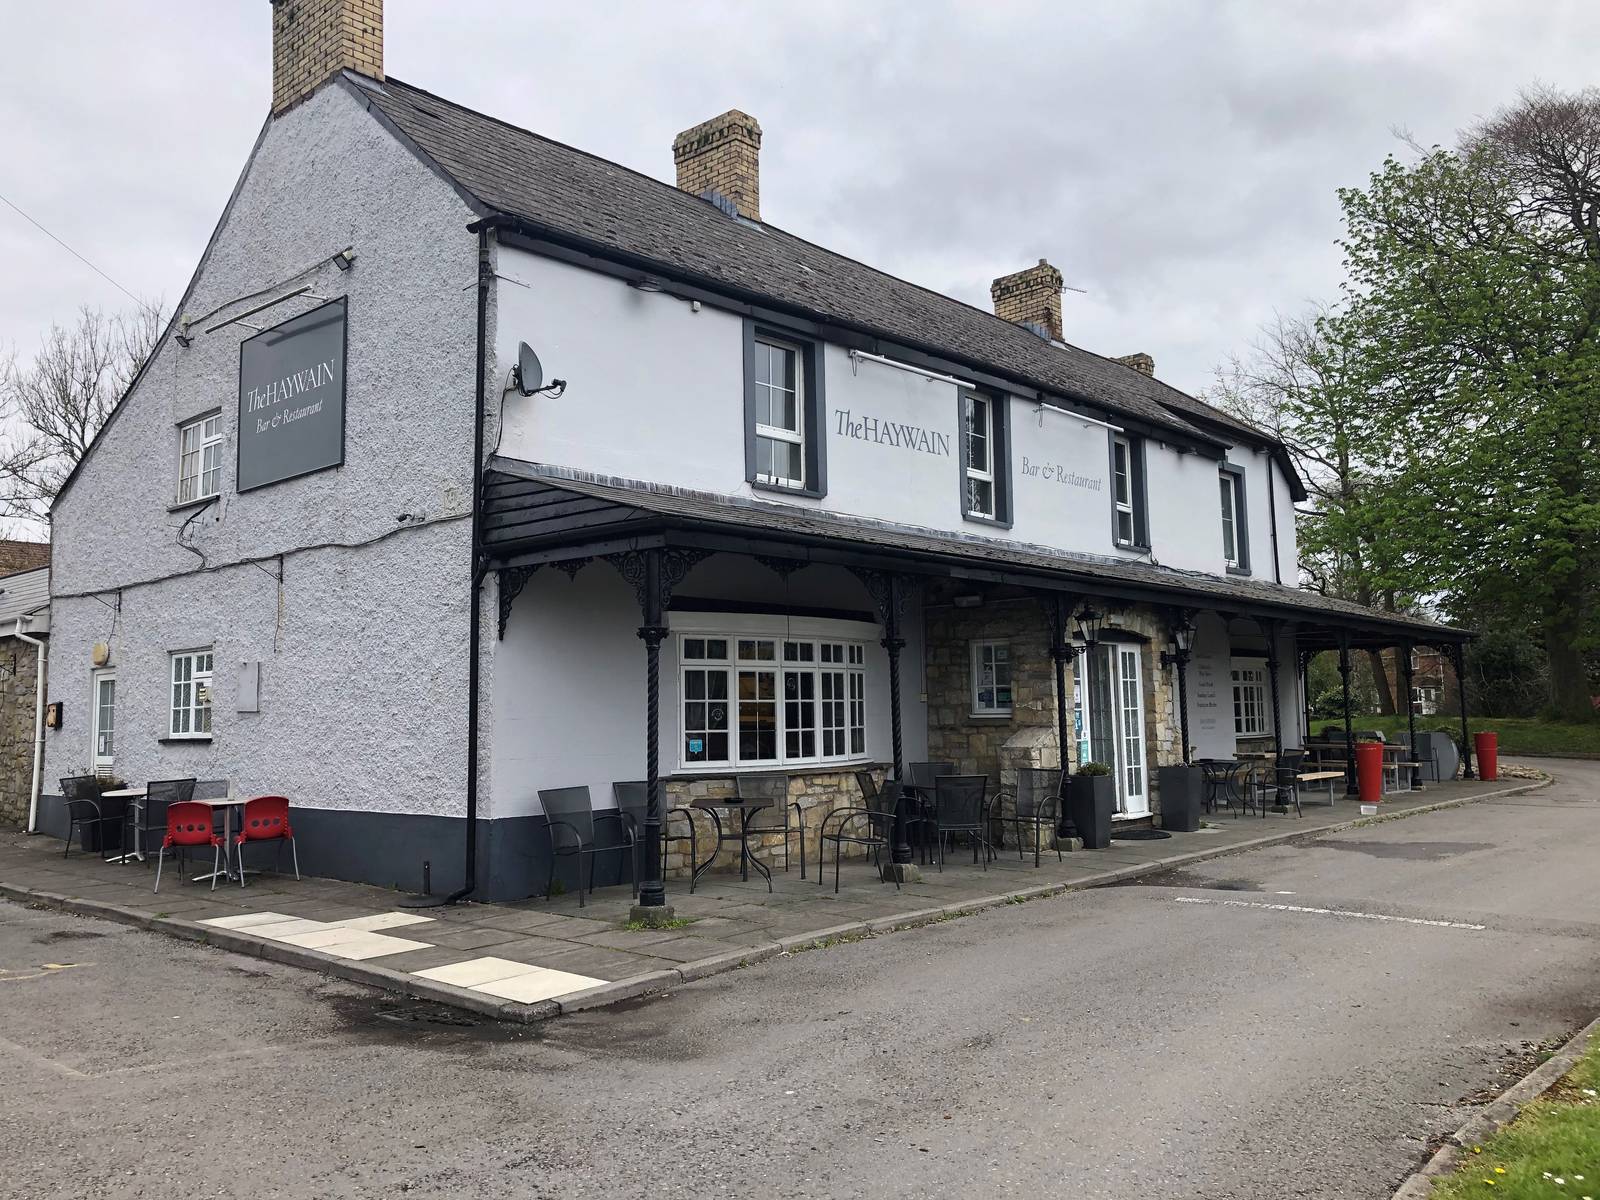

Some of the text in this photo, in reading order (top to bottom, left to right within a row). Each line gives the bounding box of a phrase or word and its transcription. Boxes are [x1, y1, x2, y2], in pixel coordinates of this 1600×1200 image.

[256, 399, 323, 433] Bar & Restaurant
[1022, 456, 1102, 492] Bar & Restaurant
